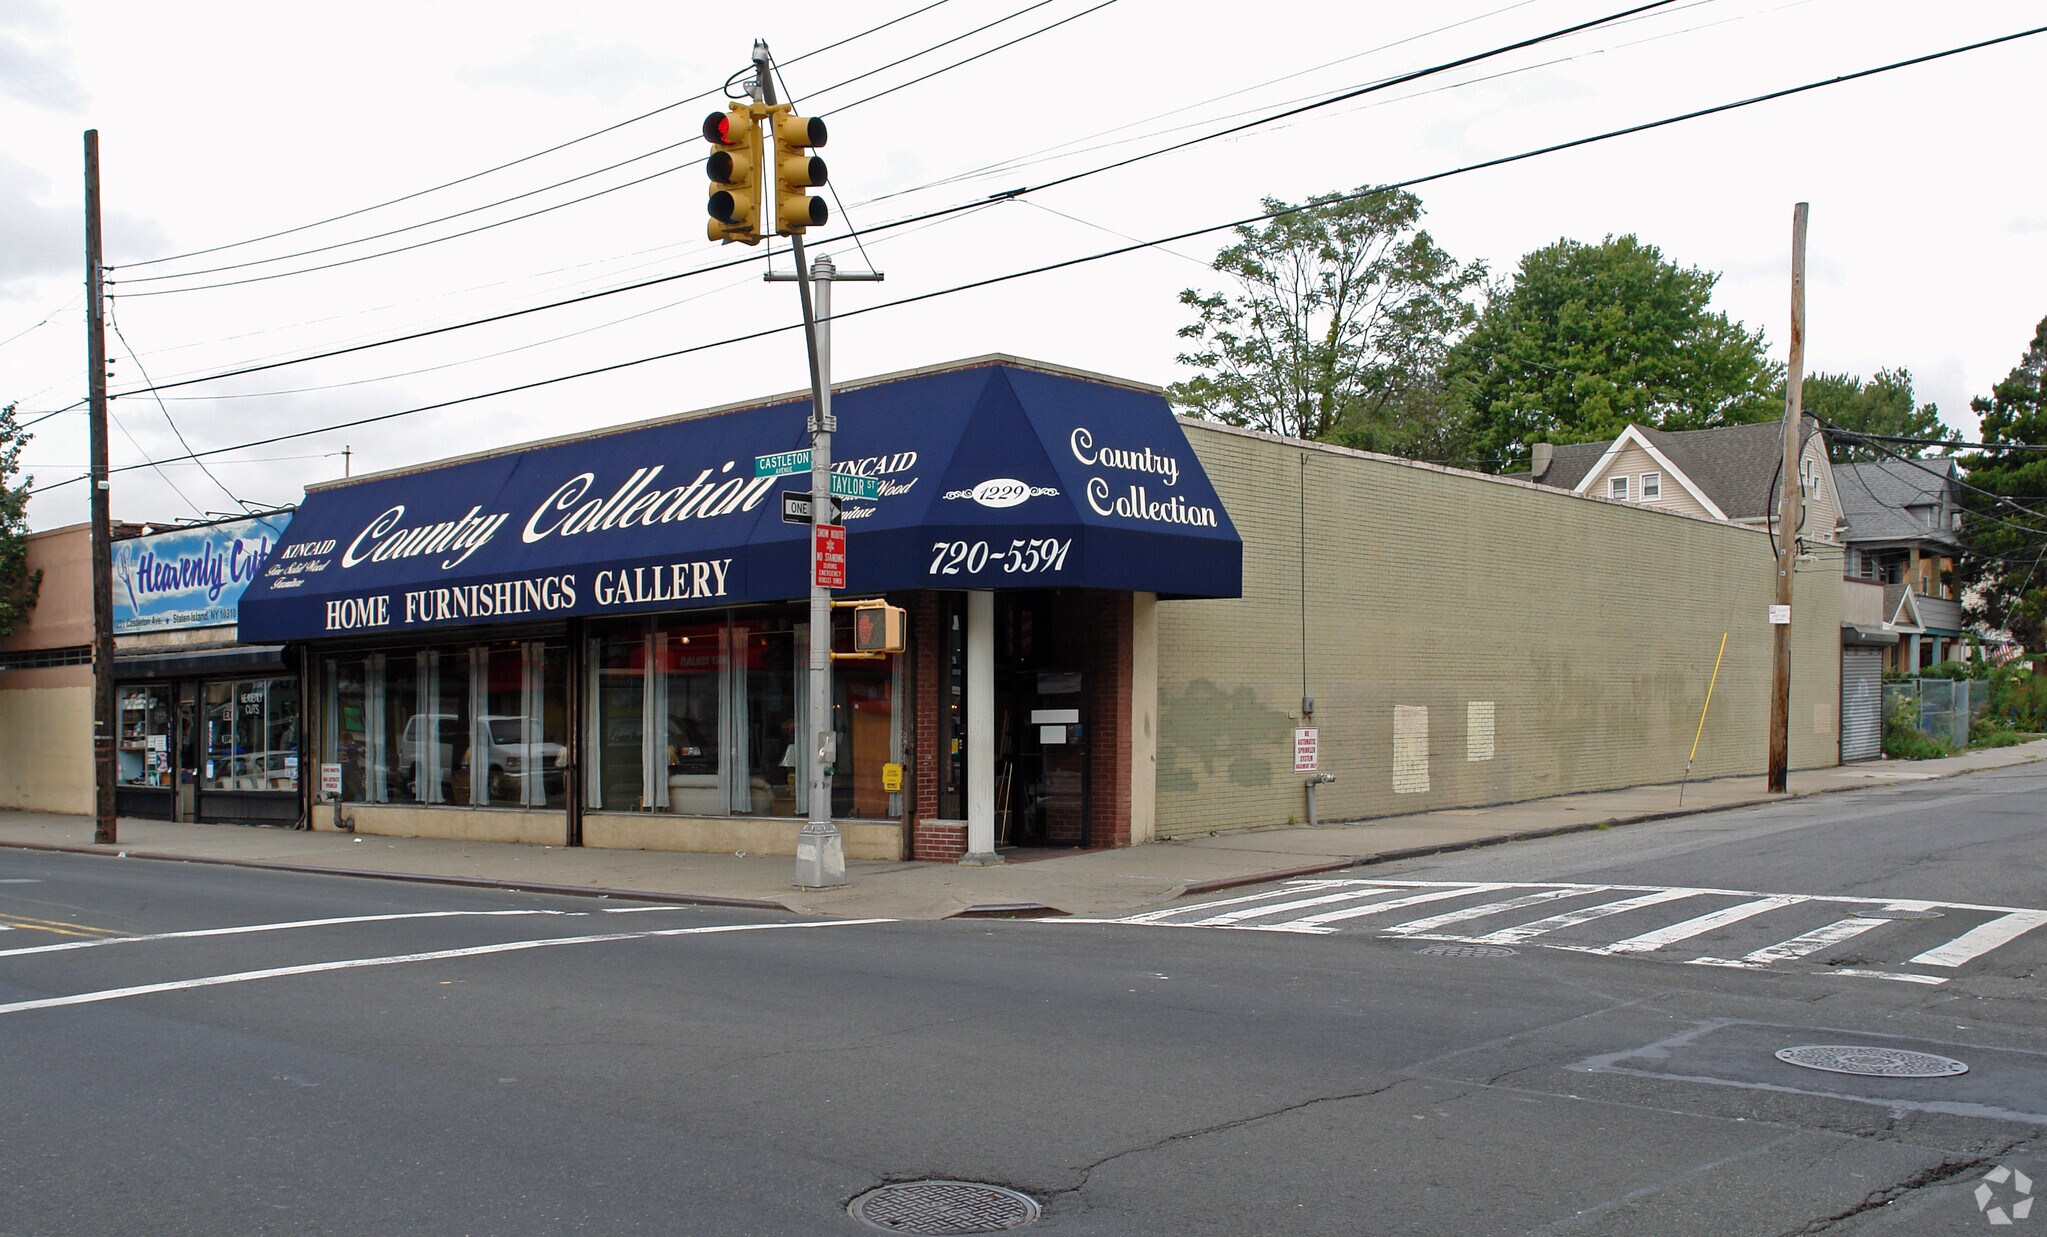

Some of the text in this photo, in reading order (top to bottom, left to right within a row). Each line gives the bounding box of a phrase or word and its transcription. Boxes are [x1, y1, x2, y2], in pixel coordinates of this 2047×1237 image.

[759, 451, 809, 469] CASTLETON
[1070, 427, 1179, 487] Country
[775, 466, 793, 474] AVENUE
[832, 475, 875, 496] TAYLOR ST
[877, 477, 919, 497] Wood
[978, 485, 1024, 501] 1229
[791, 502, 807, 514] ONE
[1086, 476, 1217, 528] Collection
[341, 460, 779, 570] Country Collection
[281, 540, 336, 559] KINCAID
[929, 538, 1072, 575] 720-5591
[137, 535, 276, 602] Heavenly Cut
[594, 558, 733, 606] GALLERY
[405, 575, 577, 624] FURNISHINGS
[172, 613, 190, 624] Staten
[210, 610, 219, 620] NY
[220, 608, 237, 619] 10310
[326, 595, 391, 631] HOME
[245, 704, 260, 715] CUTS
